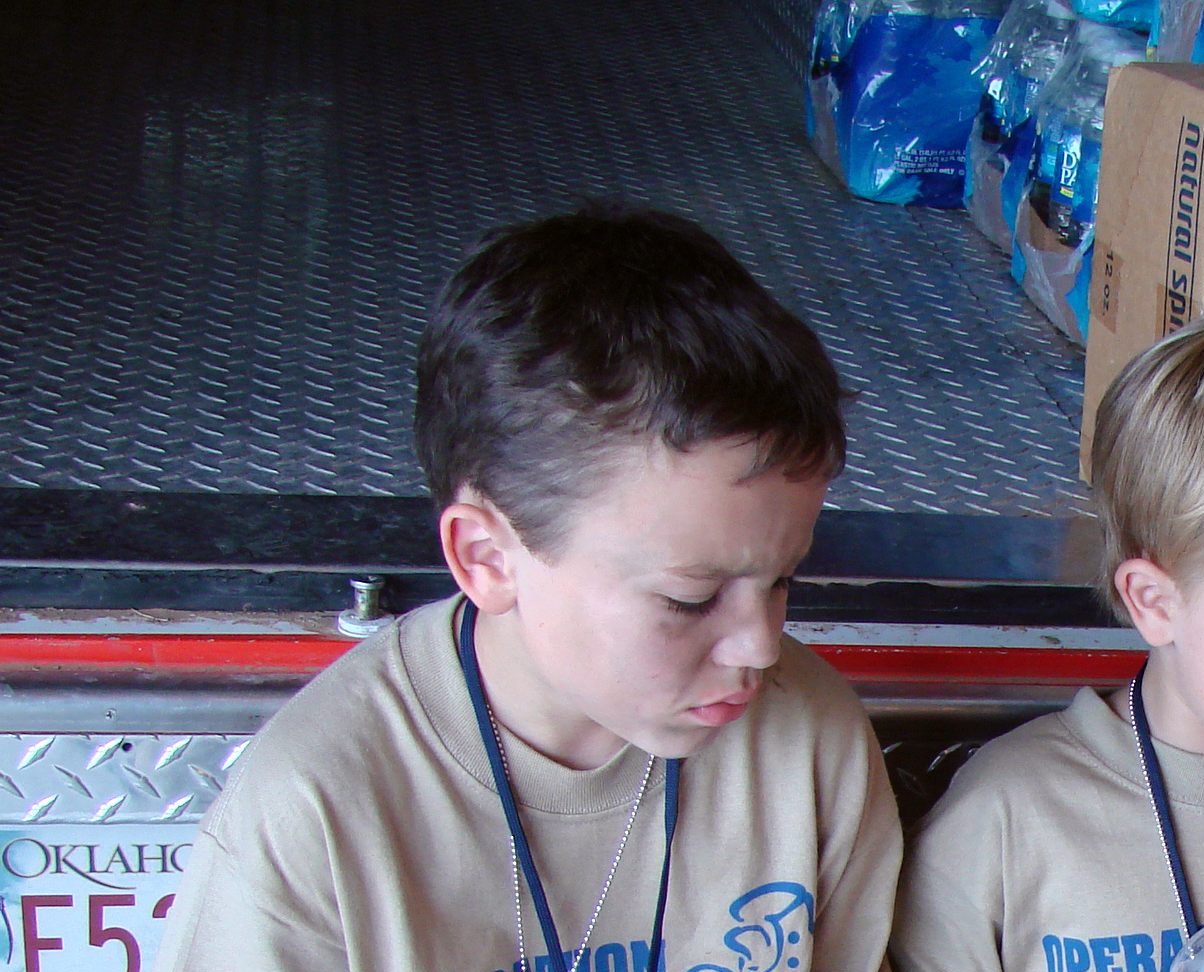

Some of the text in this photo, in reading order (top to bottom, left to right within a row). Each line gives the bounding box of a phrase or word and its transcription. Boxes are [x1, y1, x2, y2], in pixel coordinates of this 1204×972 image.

[1105, 250, 1114, 278] 12
[1168, 121, 1201, 334] natural spr
